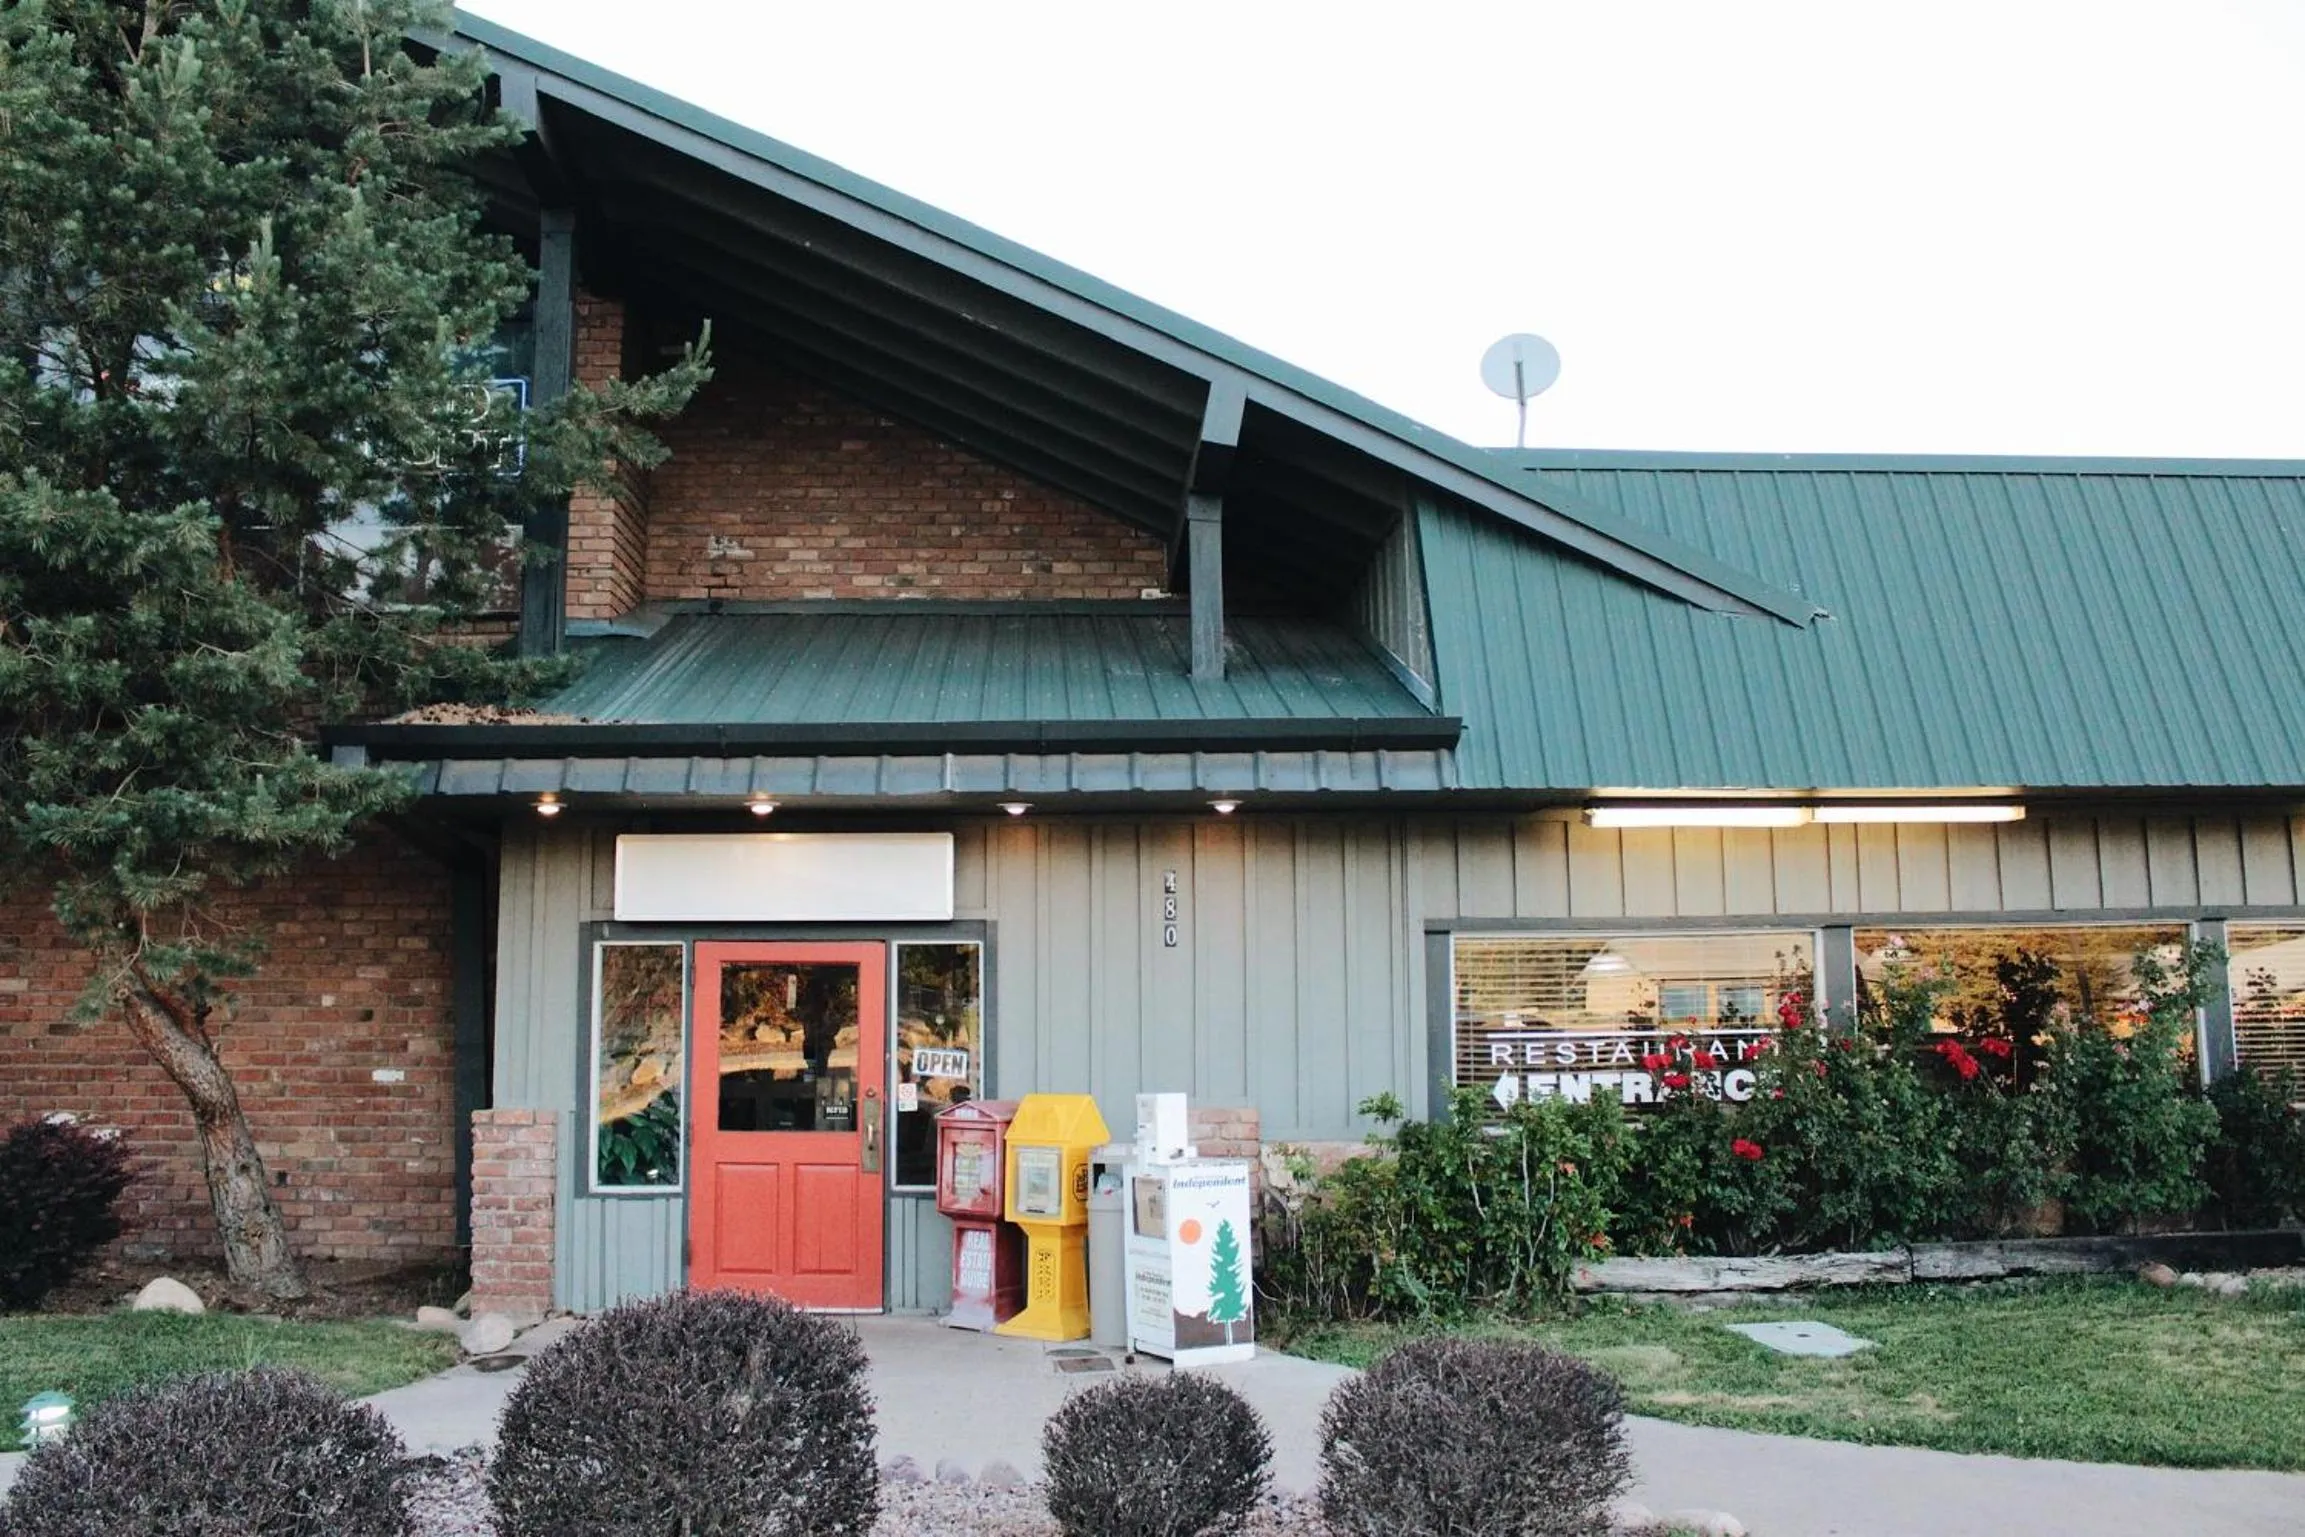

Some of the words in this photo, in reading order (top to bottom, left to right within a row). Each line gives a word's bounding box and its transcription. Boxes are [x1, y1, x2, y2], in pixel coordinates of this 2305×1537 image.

[916, 1051, 964, 1075] OPEN
[1527, 1068, 1779, 1104] ENTRNC
[1173, 1176, 1246, 1190] Independent
